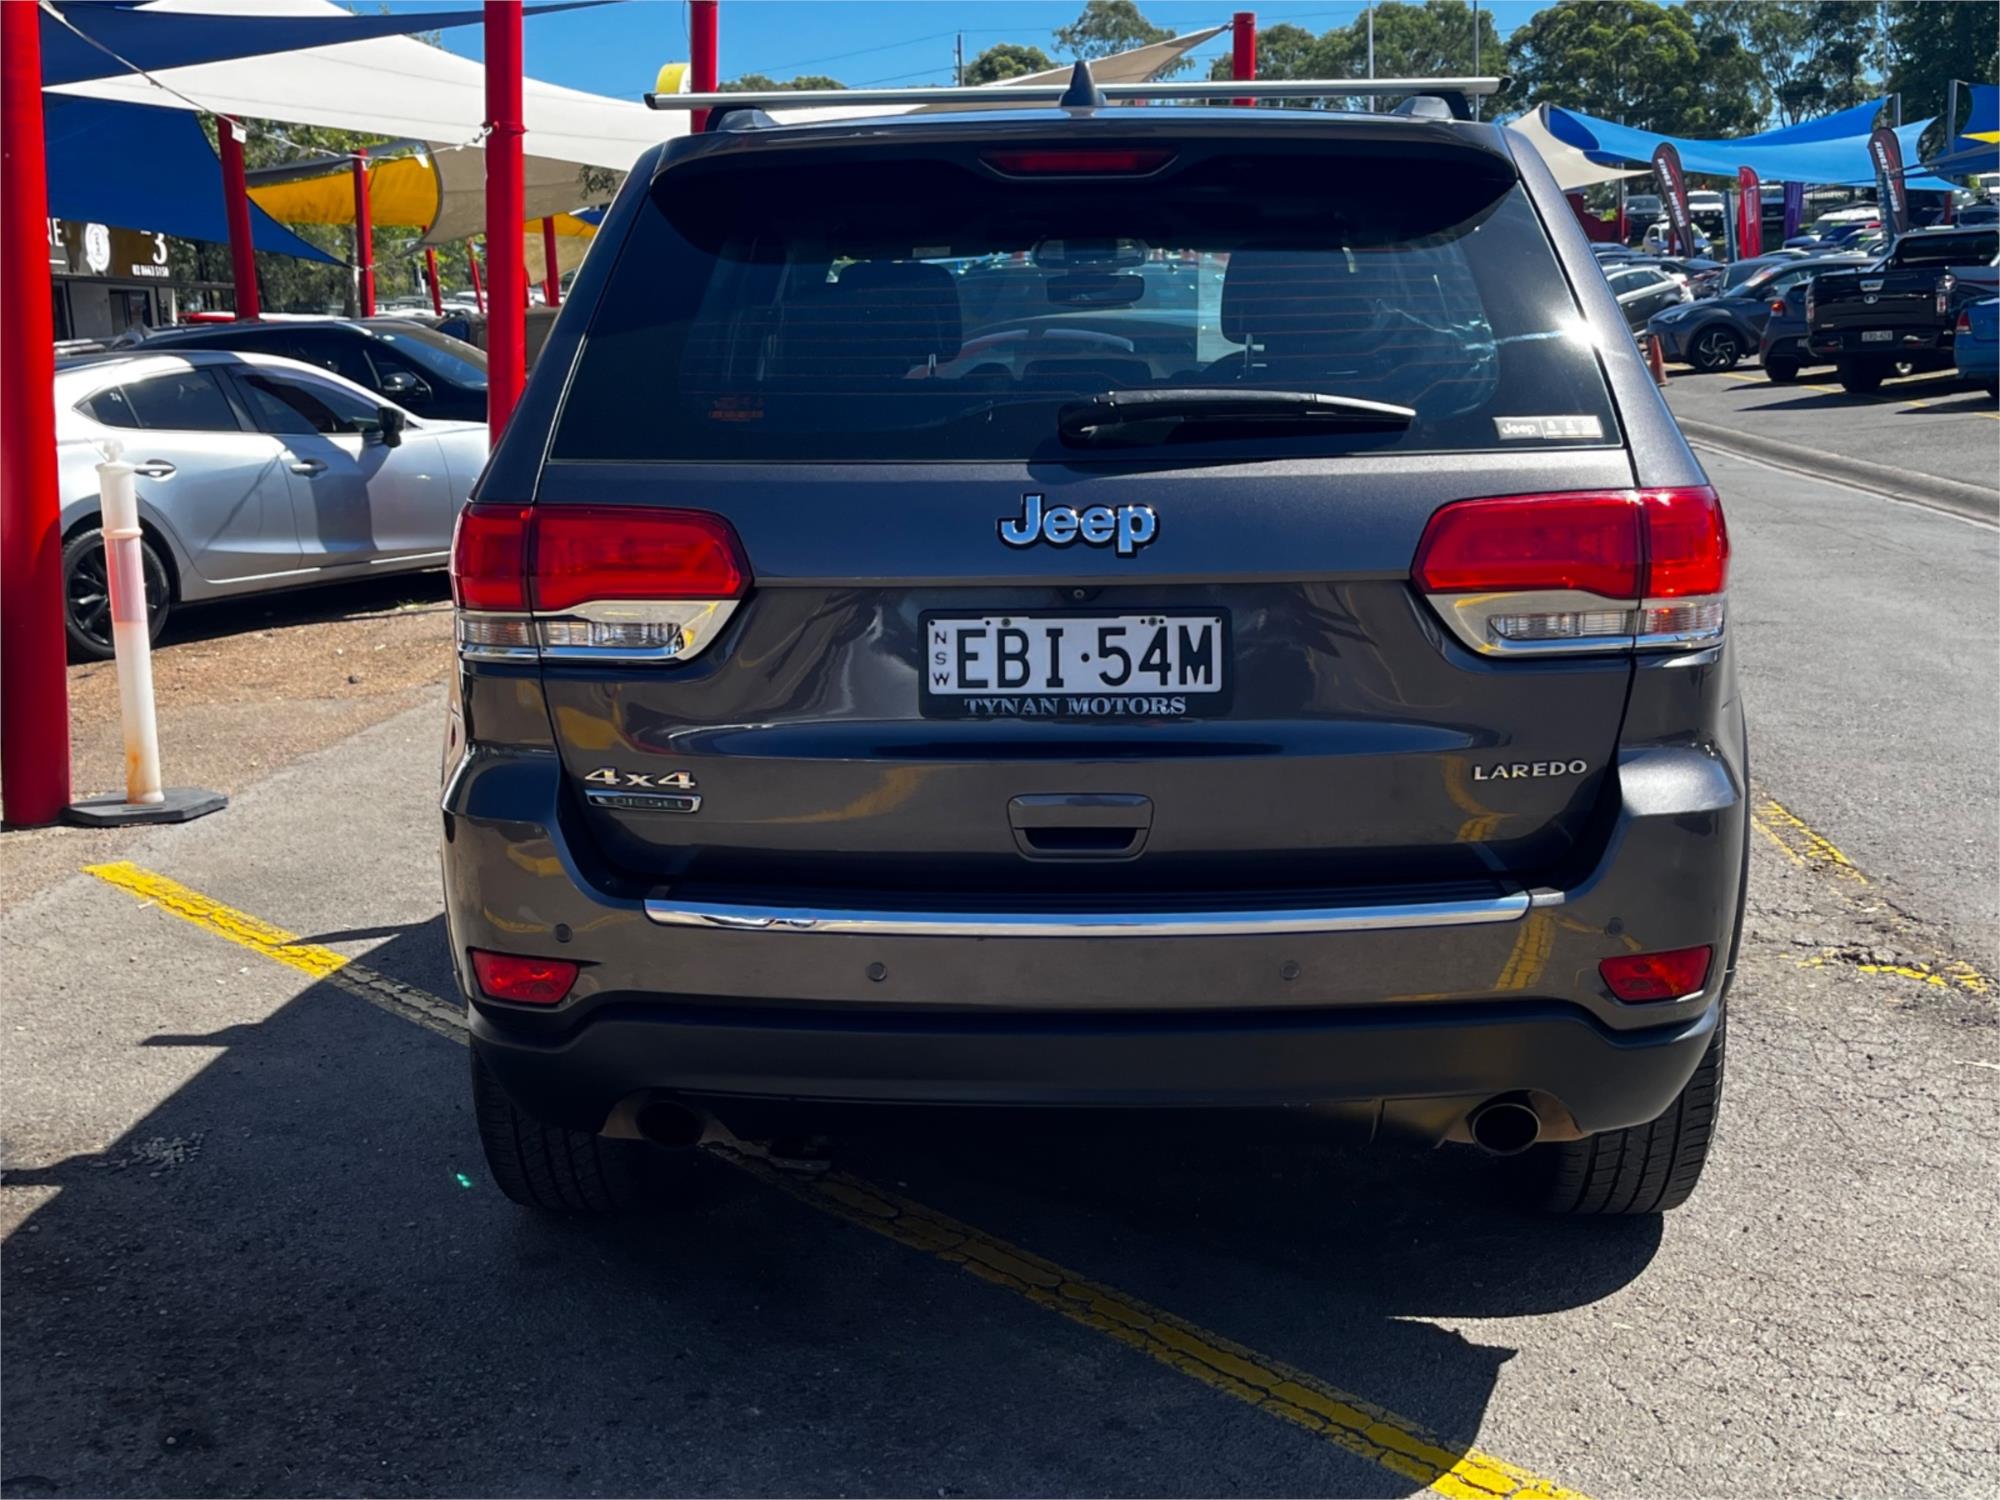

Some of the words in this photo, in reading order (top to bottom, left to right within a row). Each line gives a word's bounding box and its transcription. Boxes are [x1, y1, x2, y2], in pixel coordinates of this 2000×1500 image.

[1501, 422, 1538, 435] Jeep
[999, 494, 1157, 555] Jeep
[964, 698, 1058, 717] TYNAN
[1066, 696, 1187, 716] MOTORS
[584, 767, 696, 789] 4x4
[1473, 759, 1588, 781] LAREDO
